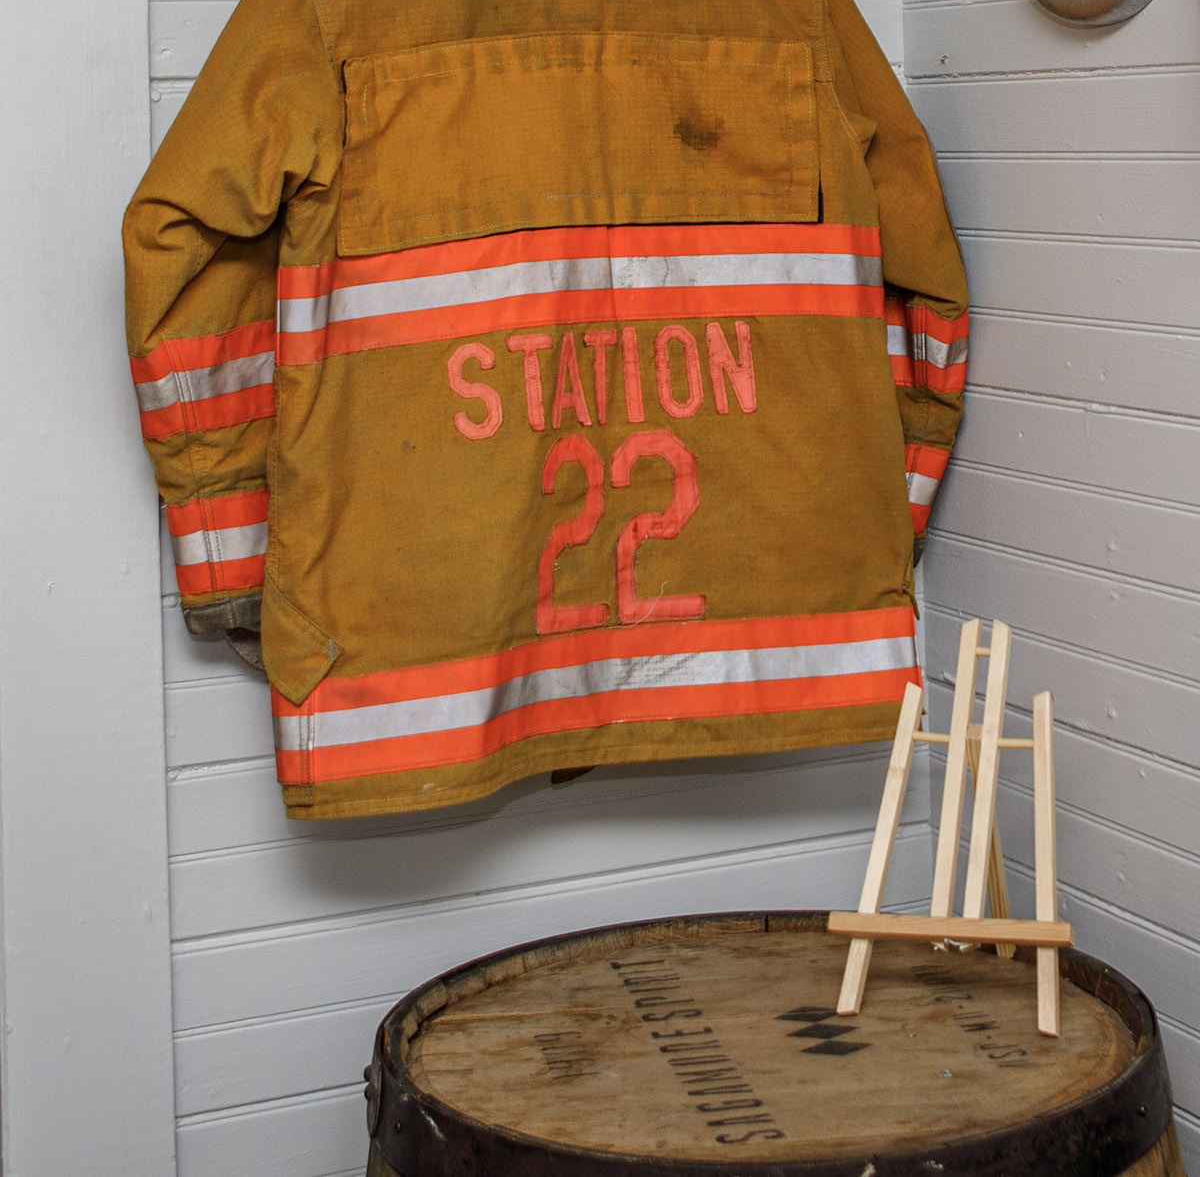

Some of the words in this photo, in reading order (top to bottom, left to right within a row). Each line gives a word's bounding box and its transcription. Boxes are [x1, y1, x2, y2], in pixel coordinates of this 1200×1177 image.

[447, 321, 757, 441] STATION
[536, 429, 706, 635] 22
[610, 959, 703, 1021] SPIRIT
[651, 1026, 786, 1143] SAGAMORE
